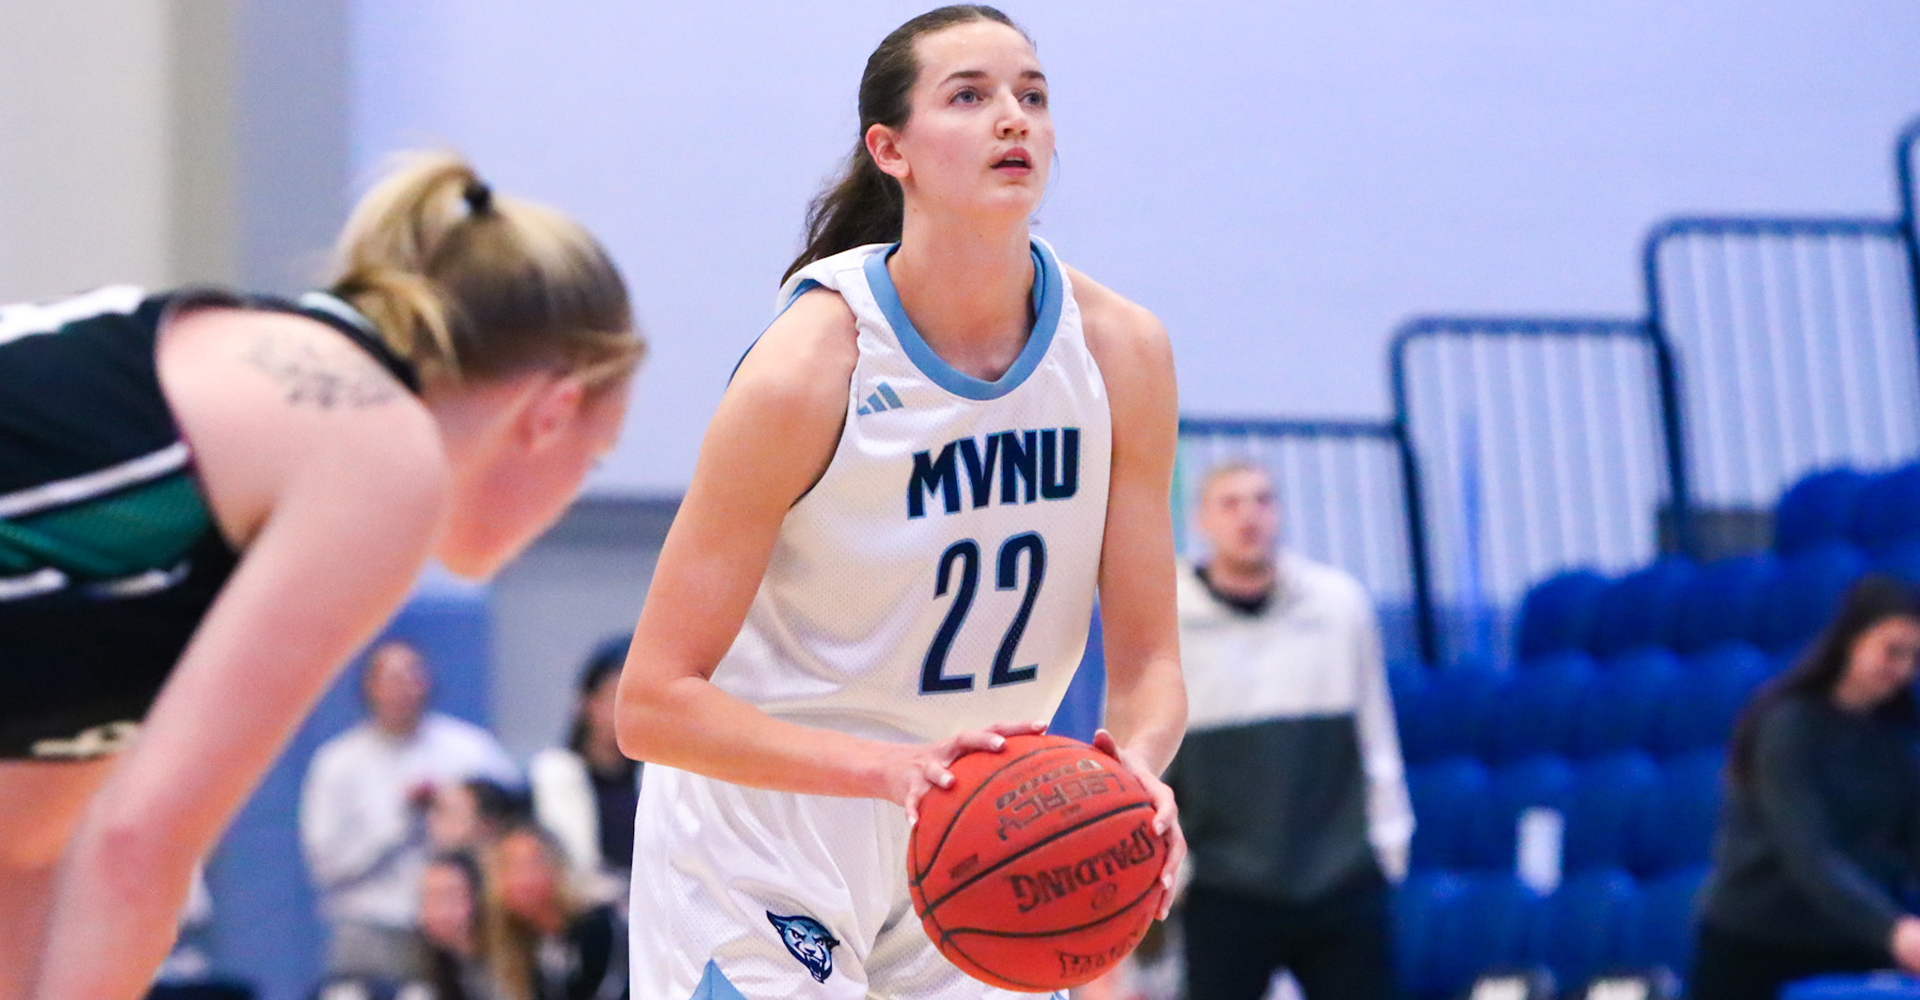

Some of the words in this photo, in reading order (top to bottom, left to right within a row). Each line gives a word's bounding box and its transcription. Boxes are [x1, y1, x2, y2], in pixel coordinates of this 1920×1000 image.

[907, 427, 1081, 520] MVNU
[918, 530, 1048, 696] 22
[1008, 820, 1156, 914] SPALDING
